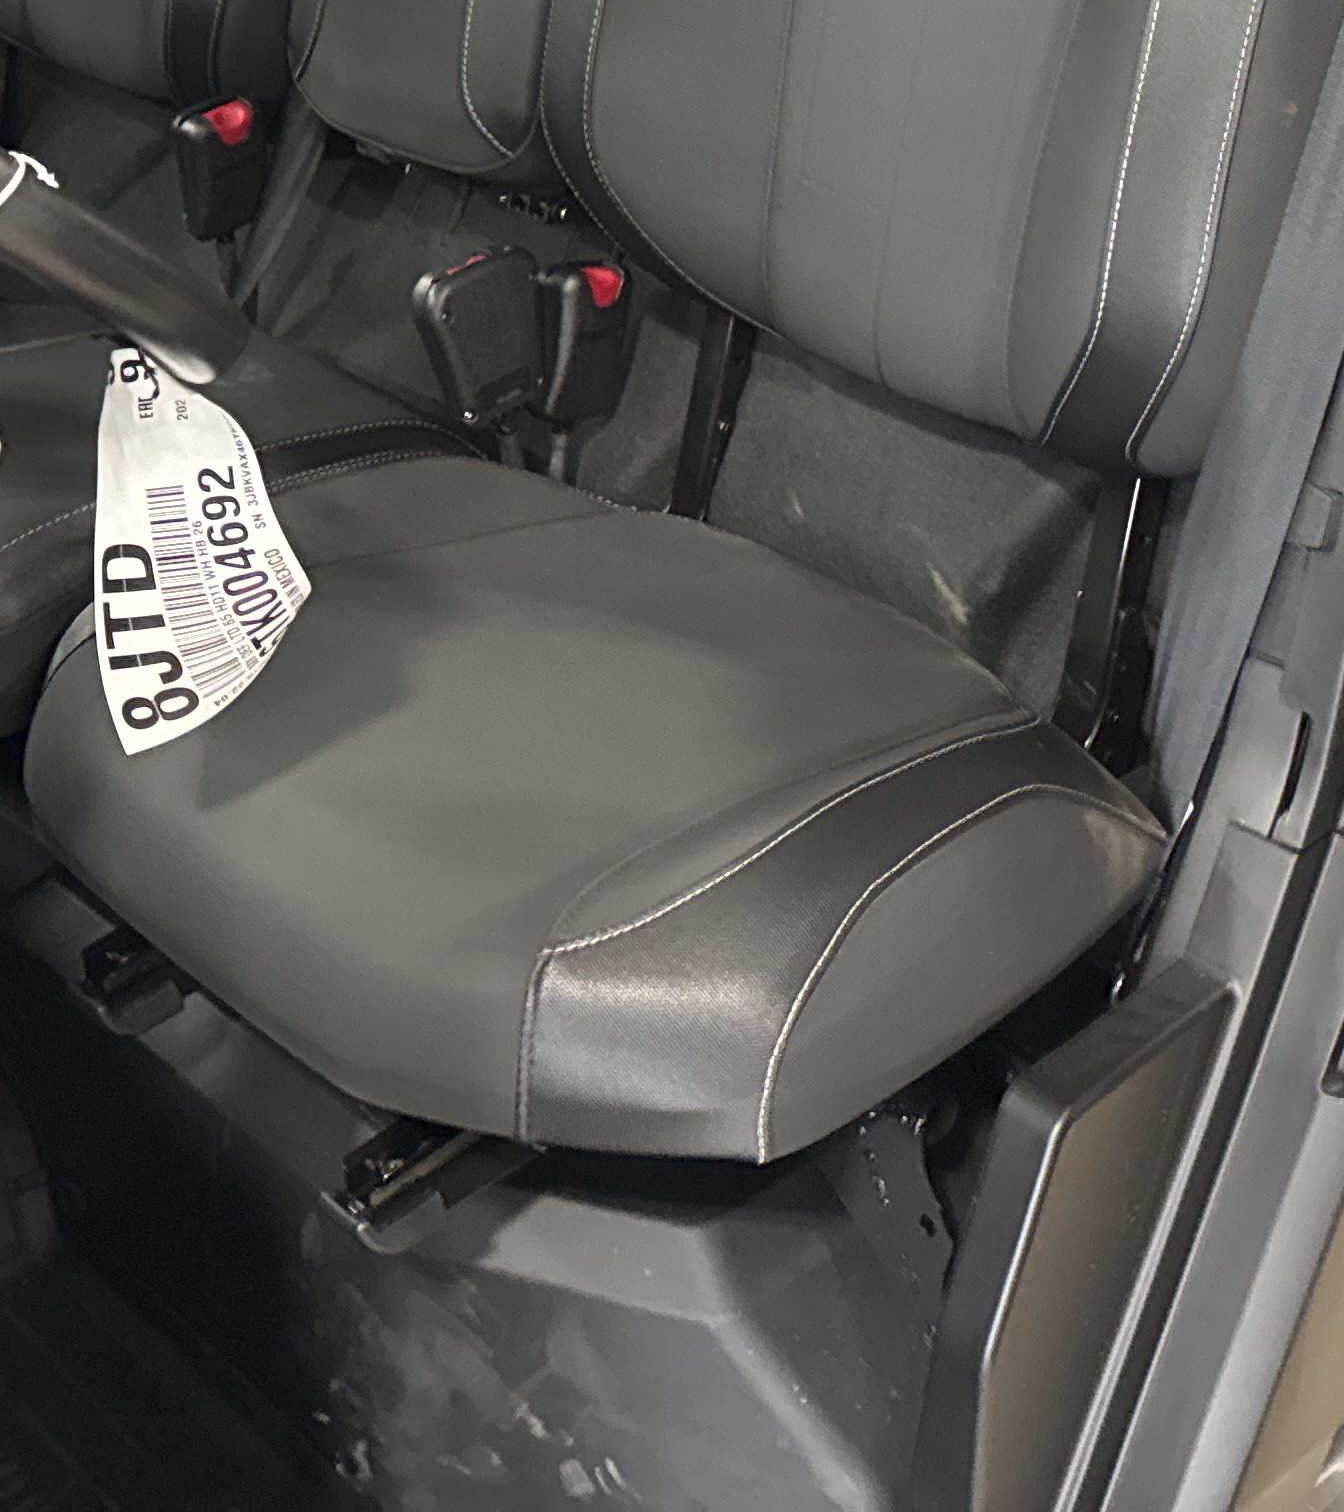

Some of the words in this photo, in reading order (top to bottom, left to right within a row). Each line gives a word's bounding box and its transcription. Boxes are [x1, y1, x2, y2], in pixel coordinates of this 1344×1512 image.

[192, 521, 204, 536] 26
[263, 548, 296, 589] MEXICO
[102, 544, 199, 730] 8JTD
